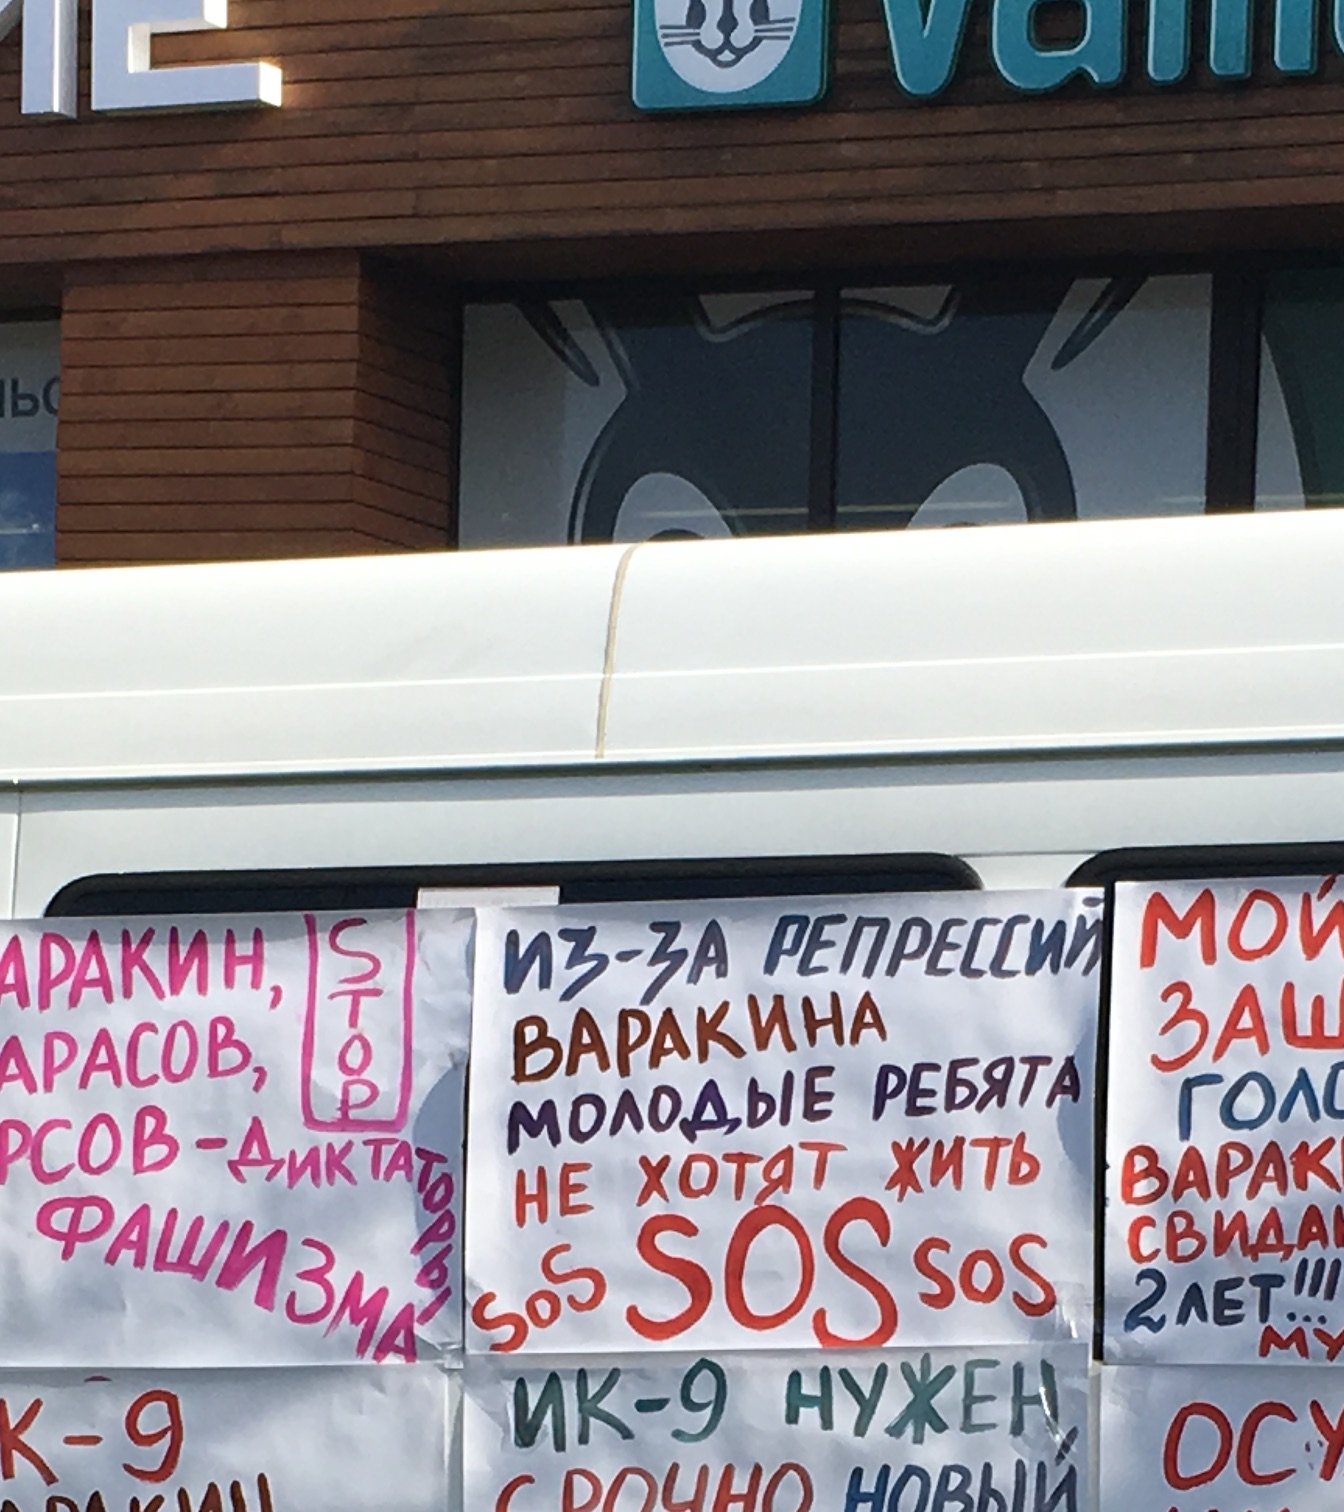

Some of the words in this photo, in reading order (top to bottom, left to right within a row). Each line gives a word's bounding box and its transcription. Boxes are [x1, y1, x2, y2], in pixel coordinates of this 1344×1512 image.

[502, 918, 728, 1006] ИЗ-ЗА
[763, 896, 1103, 981] РЕПРЕССИЙ
[327, 917, 384, 1123] STOP
[511, 990, 887, 1084] ВАРАКИНА
[506, 1065, 835, 1155] МОЛОДЫЕ
[872, 1055, 1082, 1122] РЕБЯТА
[515, 1163, 594, 1228] НЕ
[636, 1140, 847, 1207] ХОТЯТ
[885, 1131, 1041, 1202] ЖИТЬ
[36, 1195, 417, 1363] ФАШИЗМА
[625, 1197, 899, 1349] SOS
[513, 1356, 728, 1453] ИК-9
[784, 1352, 1060, 1445] НУЖЕН
